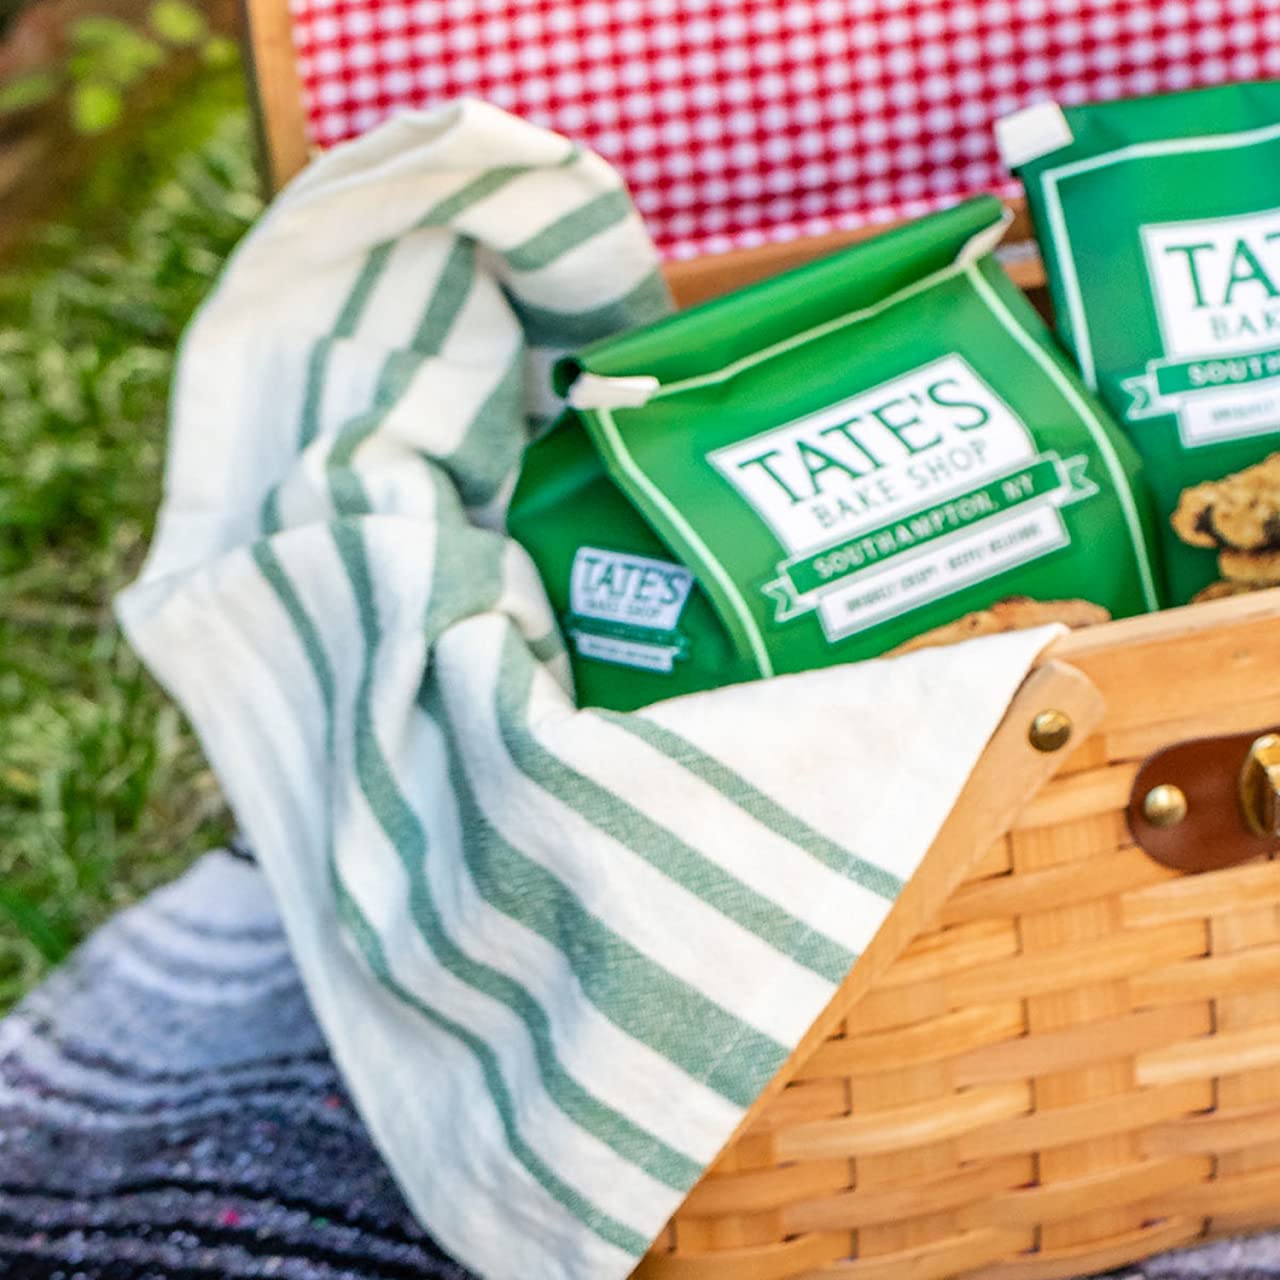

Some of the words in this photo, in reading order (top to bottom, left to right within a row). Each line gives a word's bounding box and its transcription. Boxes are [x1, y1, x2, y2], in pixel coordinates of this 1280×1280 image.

[738, 378, 990, 506] TATE'S
[811, 477, 898, 529] BAKE
[906, 439, 987, 490] SHOP
[1001, 472, 1035, 503] NY
